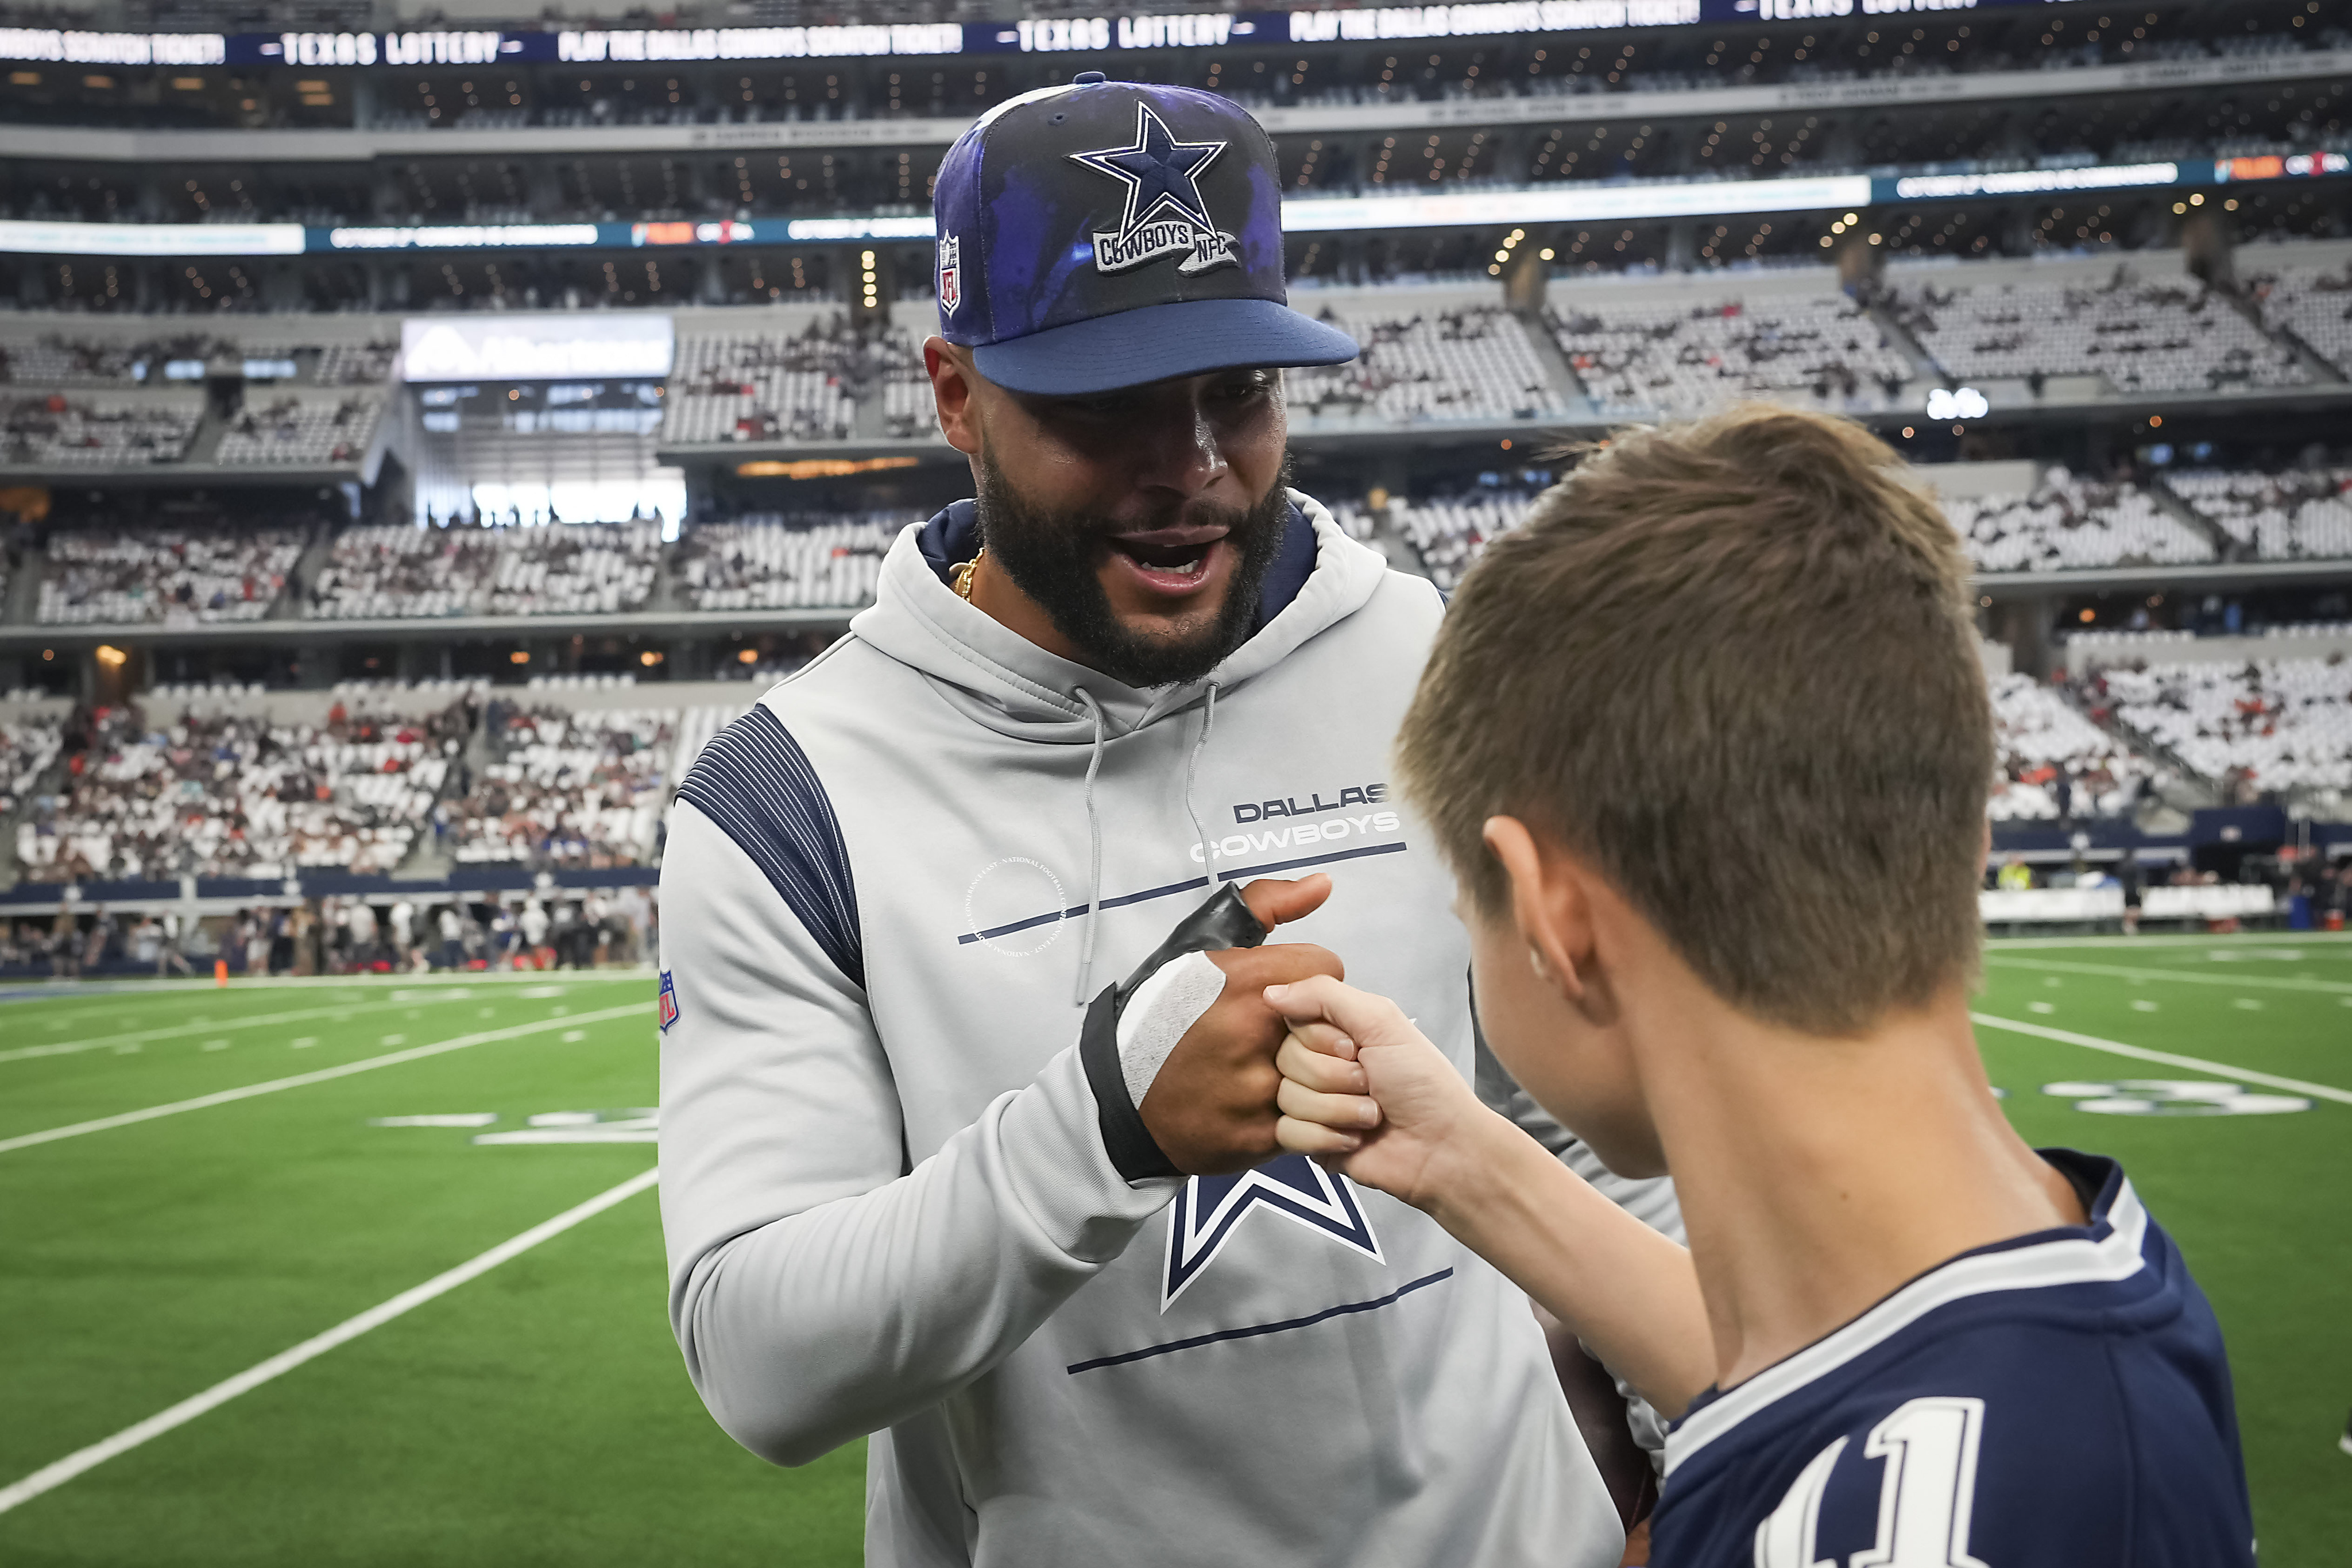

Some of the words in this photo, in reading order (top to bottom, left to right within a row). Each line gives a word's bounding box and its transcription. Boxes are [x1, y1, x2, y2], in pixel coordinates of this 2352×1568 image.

[280, 32, 377, 65] TEXAS
[385, 31, 501, 64] LOTTERY
[1016, 17, 1110, 52] TEXAS
[1117, 13, 1232, 49] LOTTERY
[1099, 224, 1189, 265] COWBOYS
[1196, 235, 1227, 262] NFC
[1233, 783, 1392, 824] DALLAS
[1189, 811, 1401, 863] COWBOYS
